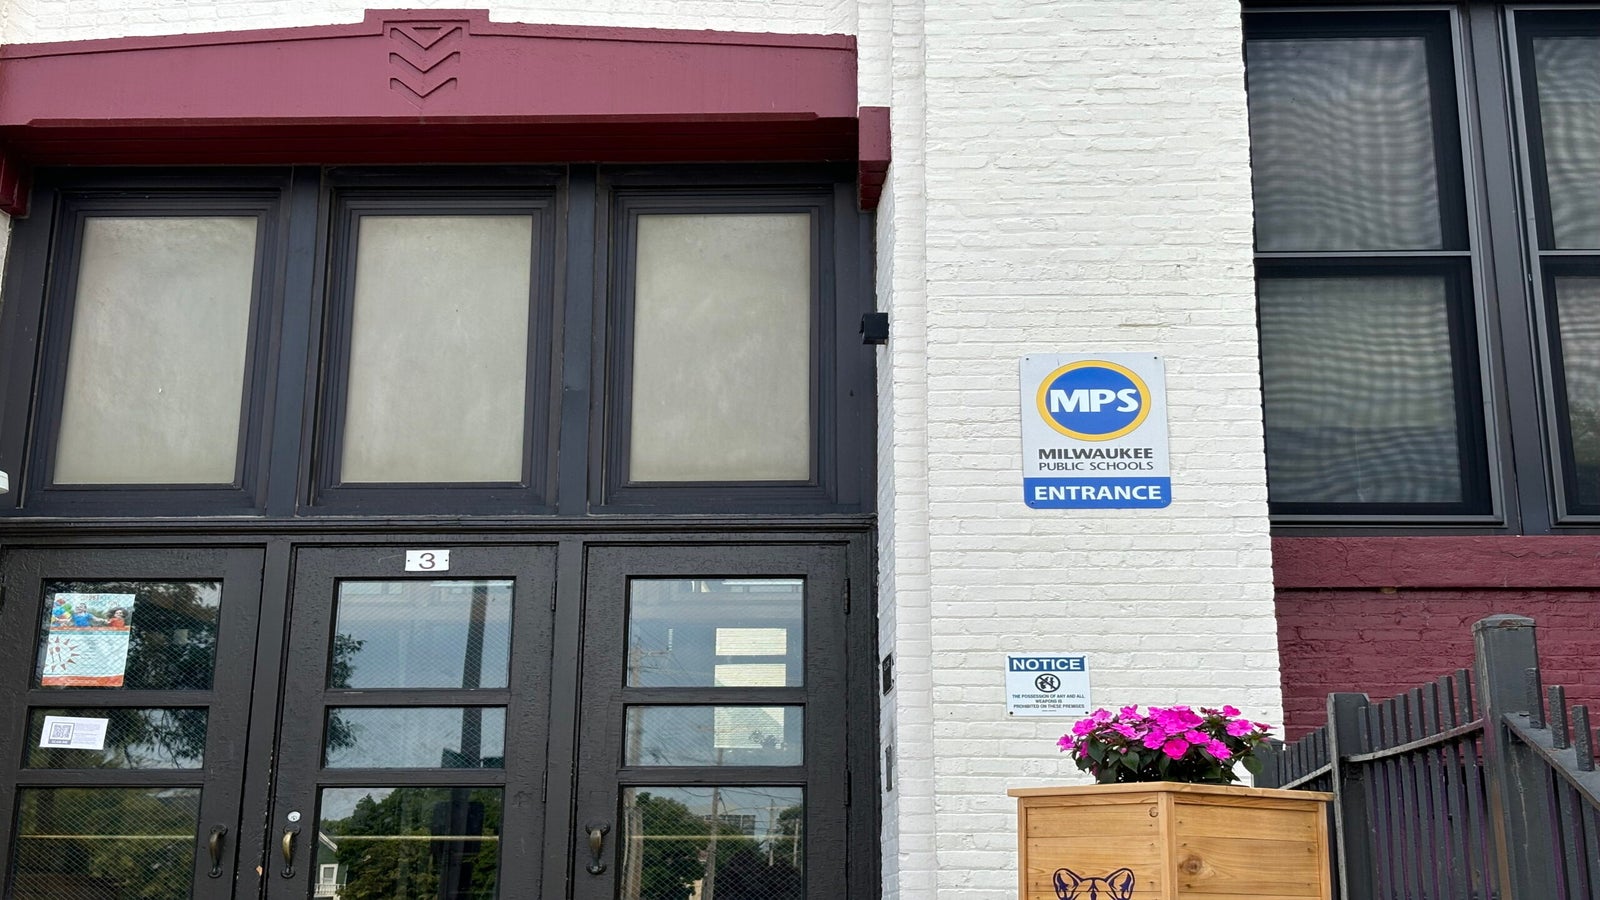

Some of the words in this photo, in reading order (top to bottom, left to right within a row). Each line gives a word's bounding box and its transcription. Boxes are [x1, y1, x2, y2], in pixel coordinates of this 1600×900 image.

[1050, 388, 1139, 413] MPS
[1038, 448, 1153, 459] MILWAUKEE
[1039, 462, 1085, 471] PUBLIC
[1089, 461, 1154, 471] SCHOOLS
[1034, 485, 1162, 501] ENTRANCE
[419, 552, 436, 570] 3
[1013, 659, 1081, 671] NOTICE
